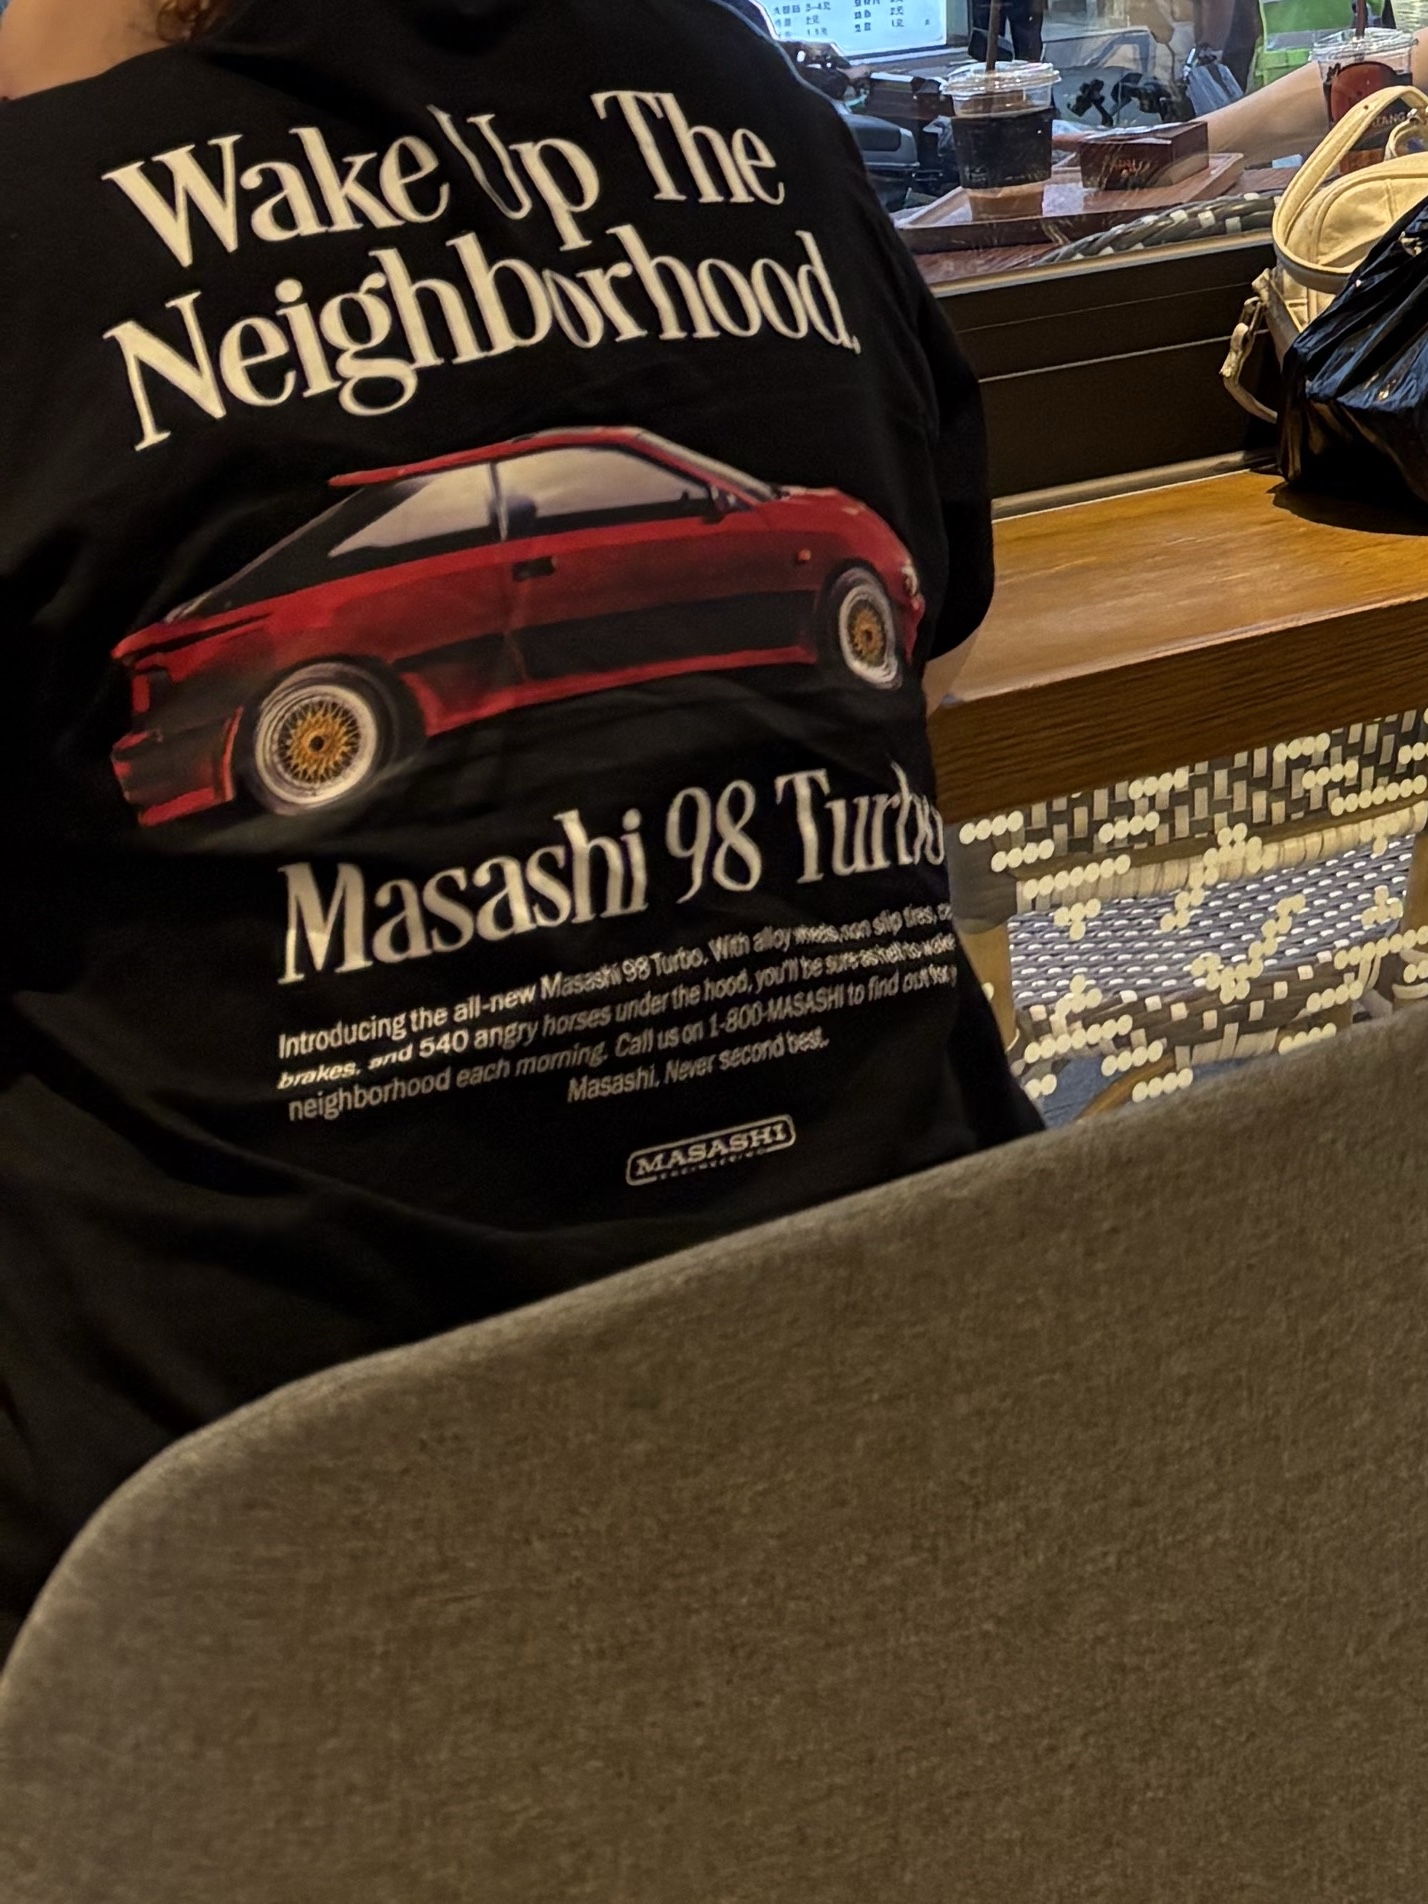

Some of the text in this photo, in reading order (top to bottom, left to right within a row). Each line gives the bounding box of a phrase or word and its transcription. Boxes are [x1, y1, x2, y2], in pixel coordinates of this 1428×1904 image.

[101, 89, 786, 269] Wake Up The
[277, 760, 946, 984] Masashi 98 Turbo
[278, 1012, 407, 1061] Introducing
[409, 1004, 448, 1033] the
[452, 982, 538, 1024] all-new
[539, 960, 623, 1001] Masashi
[622, 954, 651, 982] 98
[650, 947, 709, 977] Turbo.
[708, 930, 750, 962] With
[752, 925, 792, 954] alloy
[288, 1068, 451, 1122] neighborhood
[455, 1055, 510, 1089] each
[515, 1041, 609, 1077] morning.
[613, 1029, 654, 1059] Call
[657, 1026, 681, 1051] us
[681, 1018, 704, 1044] on
[708, 983, 845, 1039] 1-800-MASASHI
[847, 980, 866, 1007] to
[867, 967, 900, 1002] find
[368, 1041, 413, 1071] and
[418, 1027, 470, 1059] 540
[473, 1016, 539, 1051] angry
[542, 1001, 611, 1038] horses
[614, 993, 668, 1024] under
[670, 984, 700, 1009] the
[702, 974, 753, 1003] hood,
[754, 965, 799, 993] you'll
[800, 955, 824, 981] be
[567, 1063, 661, 1104] Masashi.
[664, 1052, 714, 1085] Never
[718, 1034, 787, 1070] second
[635, 1121, 789, 1177] MASASHI
